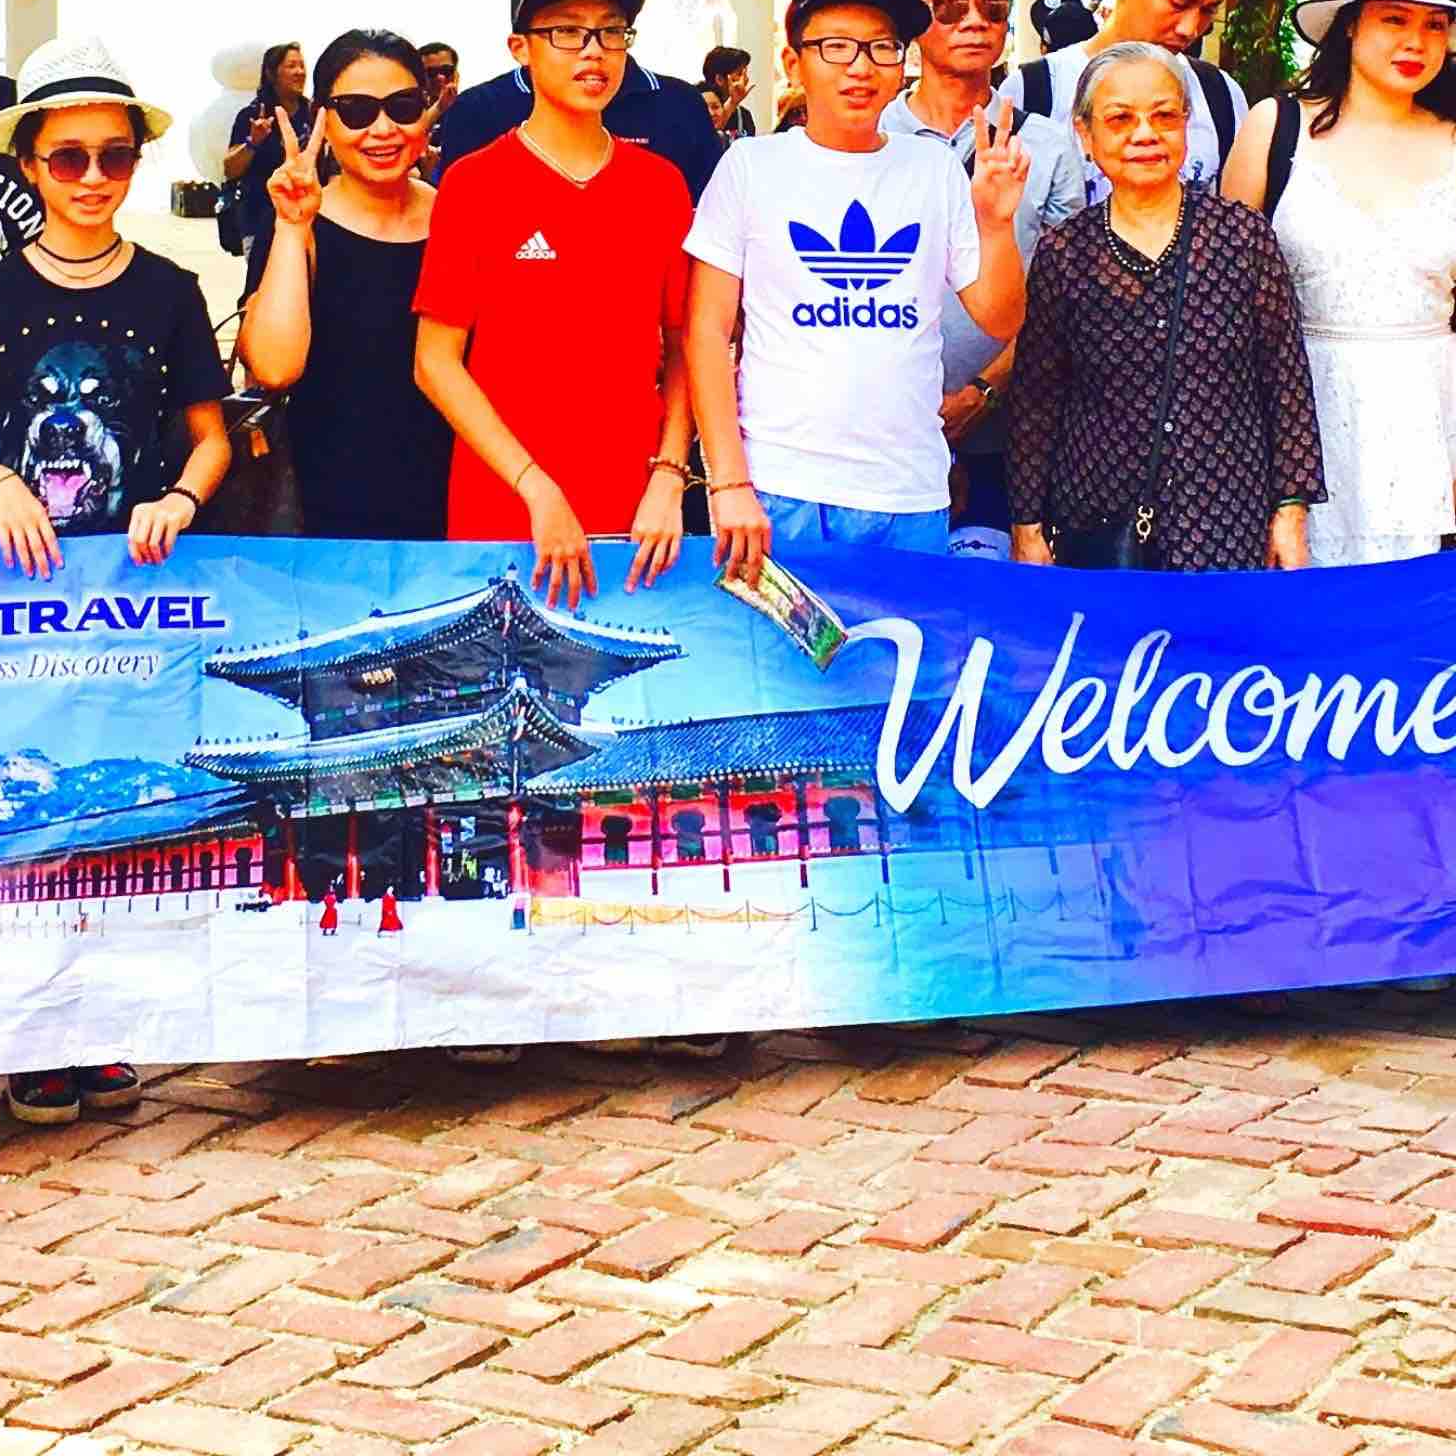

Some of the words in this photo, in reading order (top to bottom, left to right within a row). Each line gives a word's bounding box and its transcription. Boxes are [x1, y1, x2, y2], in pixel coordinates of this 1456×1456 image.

[514, 248, 557, 261] adidas
[791, 295, 919, 330] adidas
[26, 650, 161, 682] Discovery
